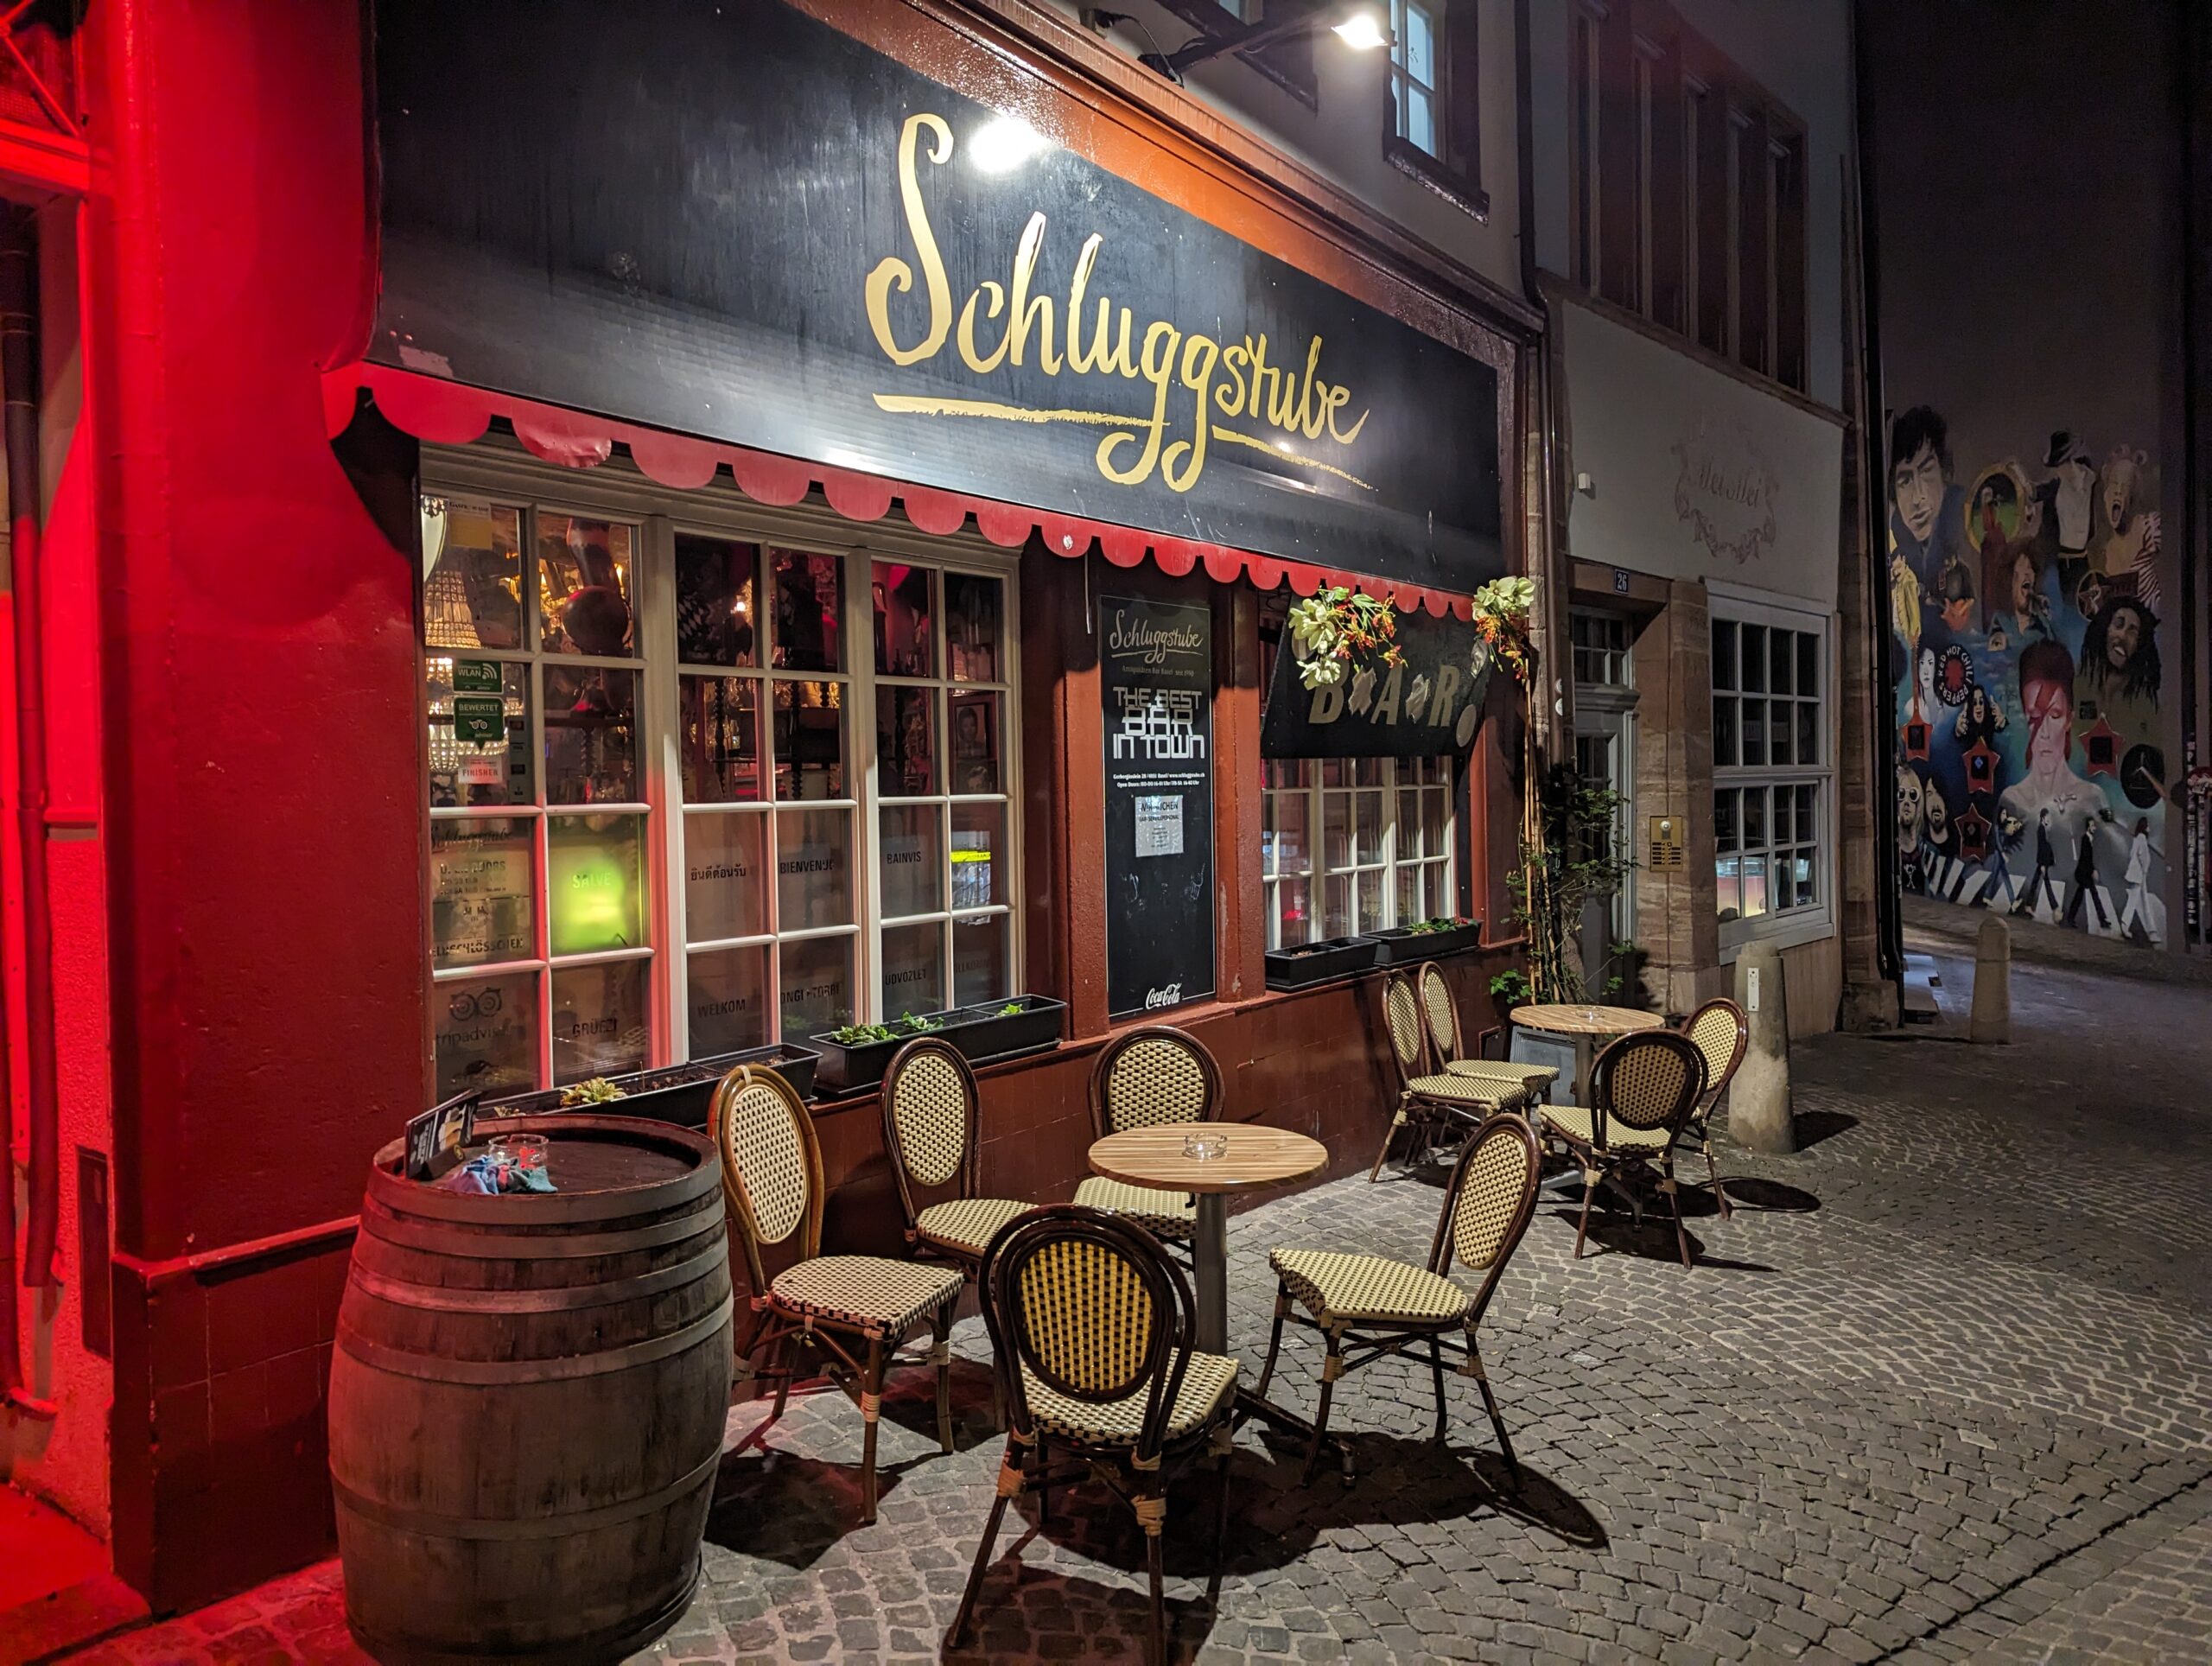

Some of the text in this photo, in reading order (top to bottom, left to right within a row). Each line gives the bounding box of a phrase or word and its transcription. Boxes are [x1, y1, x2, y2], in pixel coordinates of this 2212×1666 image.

[865, 112, 1369, 493] Schluggstube
[1617, 573, 1627, 591] 26
[1109, 609, 1203, 664] Schluggstube
[458, 669, 481, 677] WLAN
[1938, 645, 1974, 705] RED HOT CHILI PEPPERS
[459, 703, 499, 712] BEWERTET
[1113, 686, 1203, 709] THE BEST
[1122, 704, 1193, 737] BAR
[1140, 734, 1205, 760] TOWN
[887, 850, 921, 865] BAINVIS
[573, 872, 611, 888] SALVE
[690, 863, 747, 881] ยินดีต้อนรับ
[780, 989, 804, 1004] ONGI
[1146, 982, 1182, 1009] Coca-Cola
[697, 998, 746, 1018] WELKOM
[572, 1017, 617, 1038] GRÜEZI
